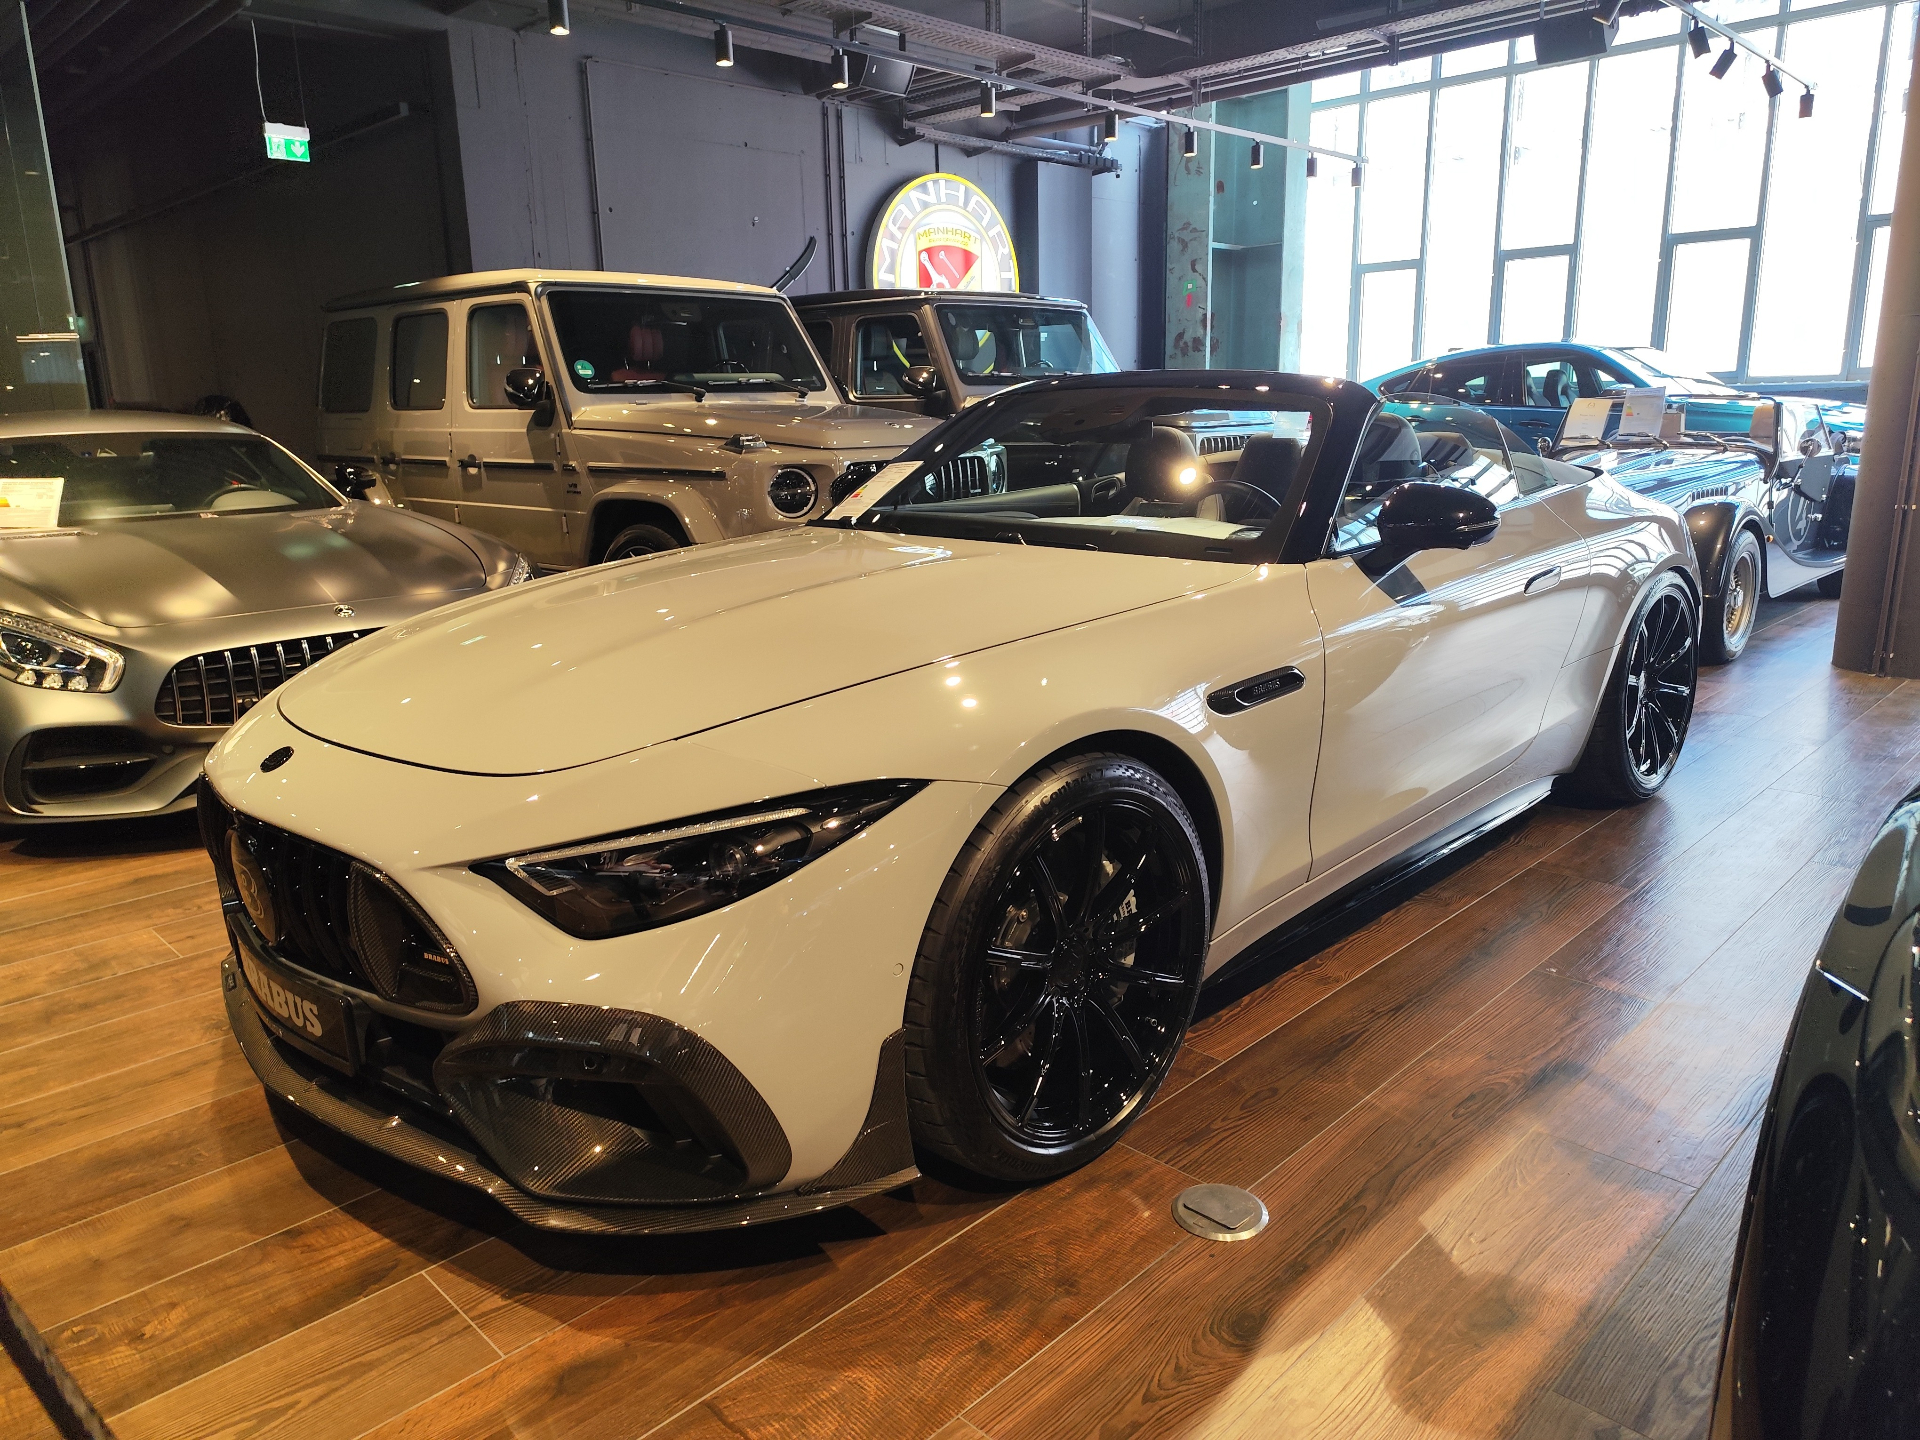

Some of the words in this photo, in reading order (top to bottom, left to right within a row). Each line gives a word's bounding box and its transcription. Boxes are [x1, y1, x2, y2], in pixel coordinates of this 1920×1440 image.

[878, 179, 1016, 292] MANHART
[917, 226, 979, 244] MANHART
[424, 952, 449, 965] BRABUS
